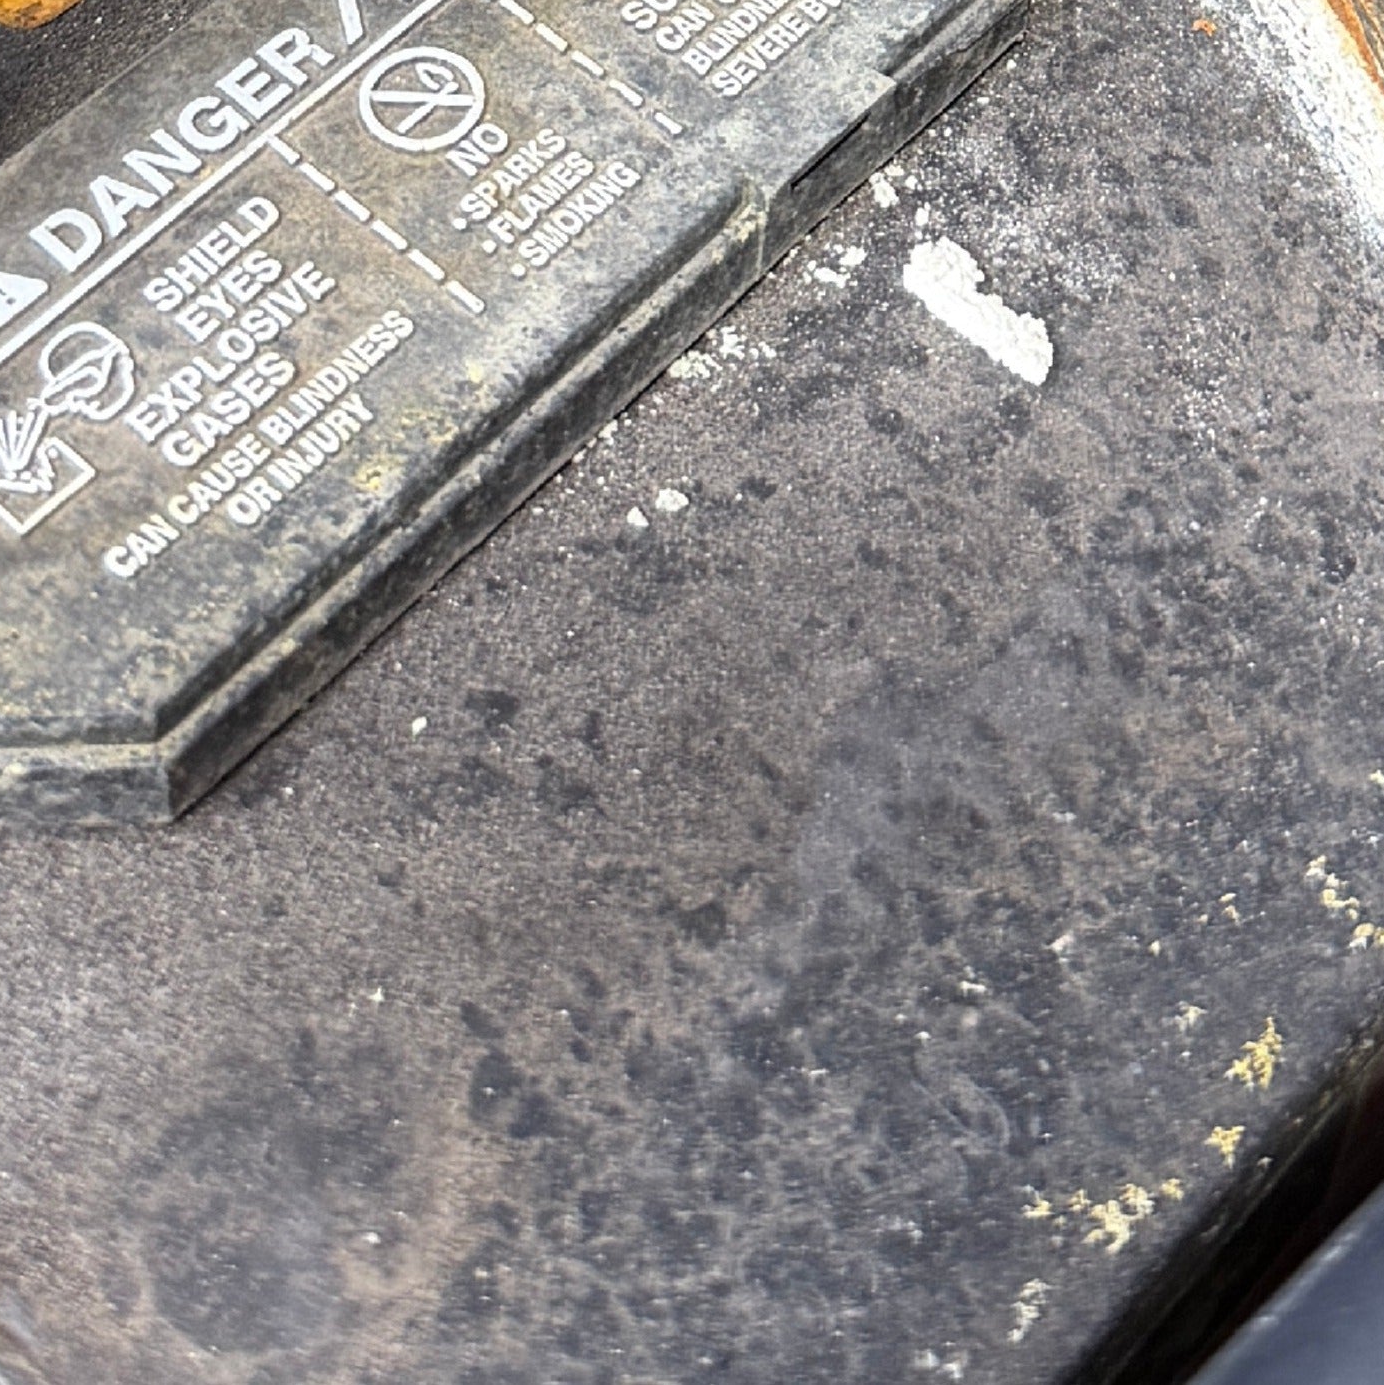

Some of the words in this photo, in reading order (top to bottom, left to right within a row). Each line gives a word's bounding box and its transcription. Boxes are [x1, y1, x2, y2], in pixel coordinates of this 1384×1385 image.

[655, 1, 715, 51] CAN
[712, 12, 812, 96] SEVERE
[29, 27, 334, 273] DANGER
[445, 122, 509, 177] NO
[460, 128, 567, 220] SPARKS
[487, 151, 595, 244] FLAMES
[142, 197, 280, 312] SHIELD
[518, 161, 641, 267] SMOKING
[175, 249, 283, 344] EYES
[125, 261, 336, 444] EXPLOSIVE
[103, 514, 180, 578] CAN
[167, 432, 271, 525] CAUSE
[257, 309, 414, 446] BLINDNESS
[161, 352, 295, 467] GASES
[226, 476, 282, 526] OR
[267, 393, 374, 491] INJURY
